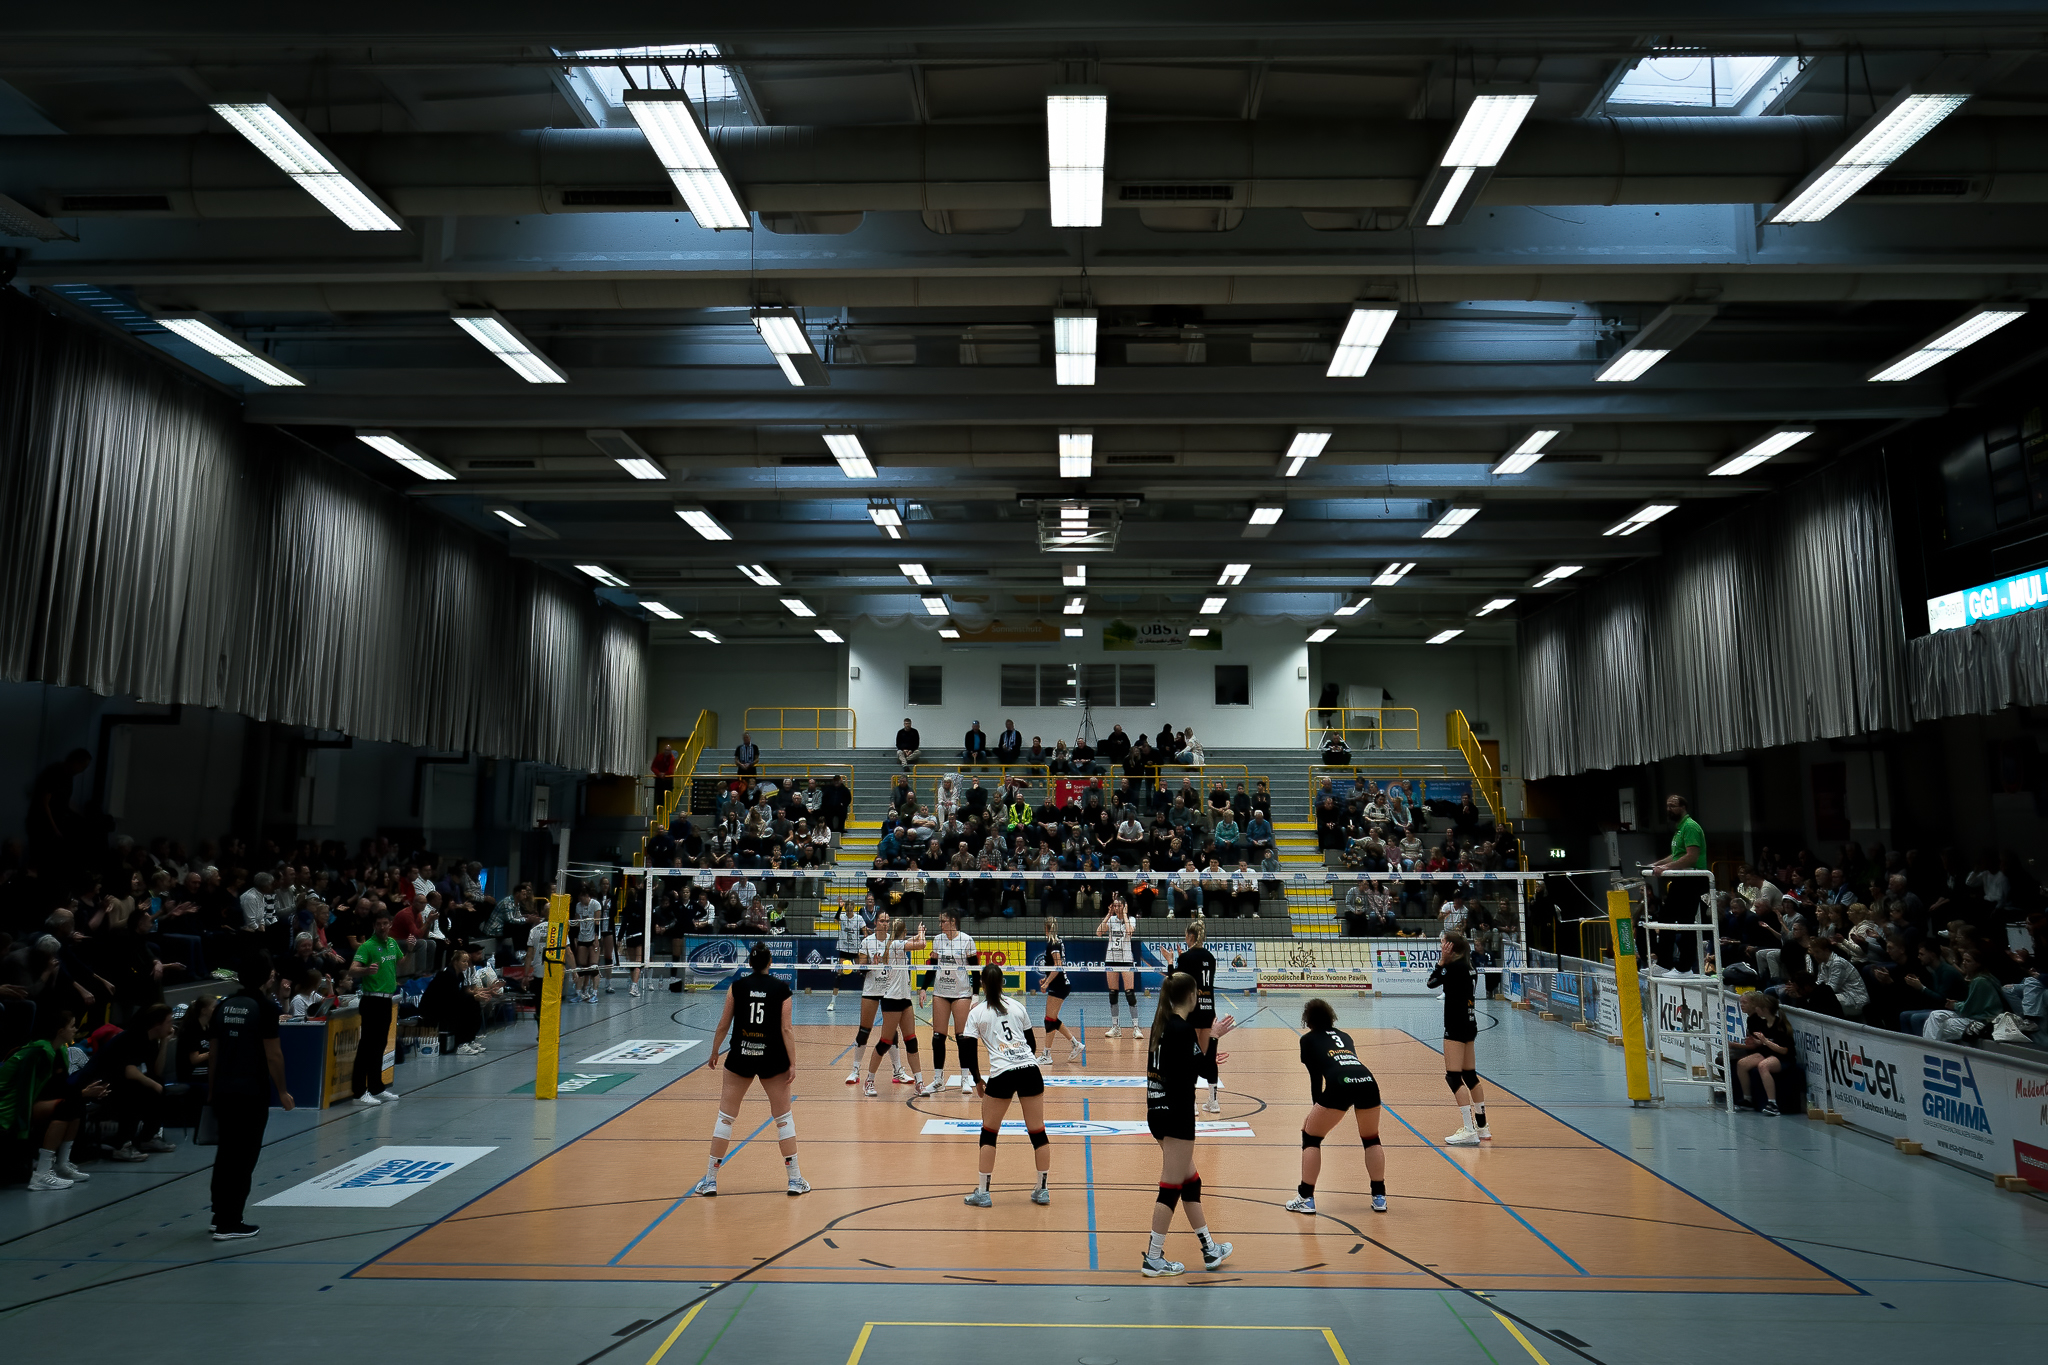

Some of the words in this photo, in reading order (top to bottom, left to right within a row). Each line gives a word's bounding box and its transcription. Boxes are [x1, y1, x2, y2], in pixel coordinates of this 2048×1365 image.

[1969, 586, 1999, 619] GGI
[2008, 571, 2048, 610] MUL
[1141, 624, 1179, 636] OBST
[1149, 942, 1188, 951] GEBALLT
[1203, 942, 1253, 951] OMPETENZ
[1409, 950, 1442, 961] STADT
[976, 951, 1007, 966] TTO
[1201, 969, 1210, 987] 14
[749, 1001, 765, 1025] 15
[1001, 1021, 1013, 1041] 5
[1331, 1034, 1345, 1049] 3
[1826, 1036, 1898, 1103] küster
[1923, 1054, 1984, 1107] ESA
[1861, 1099, 1884, 1116] Autohaus
[1922, 1092, 1992, 1135] GRIMMA
[1937, 1139, 1984, 1161] www.esa-grimma.de
